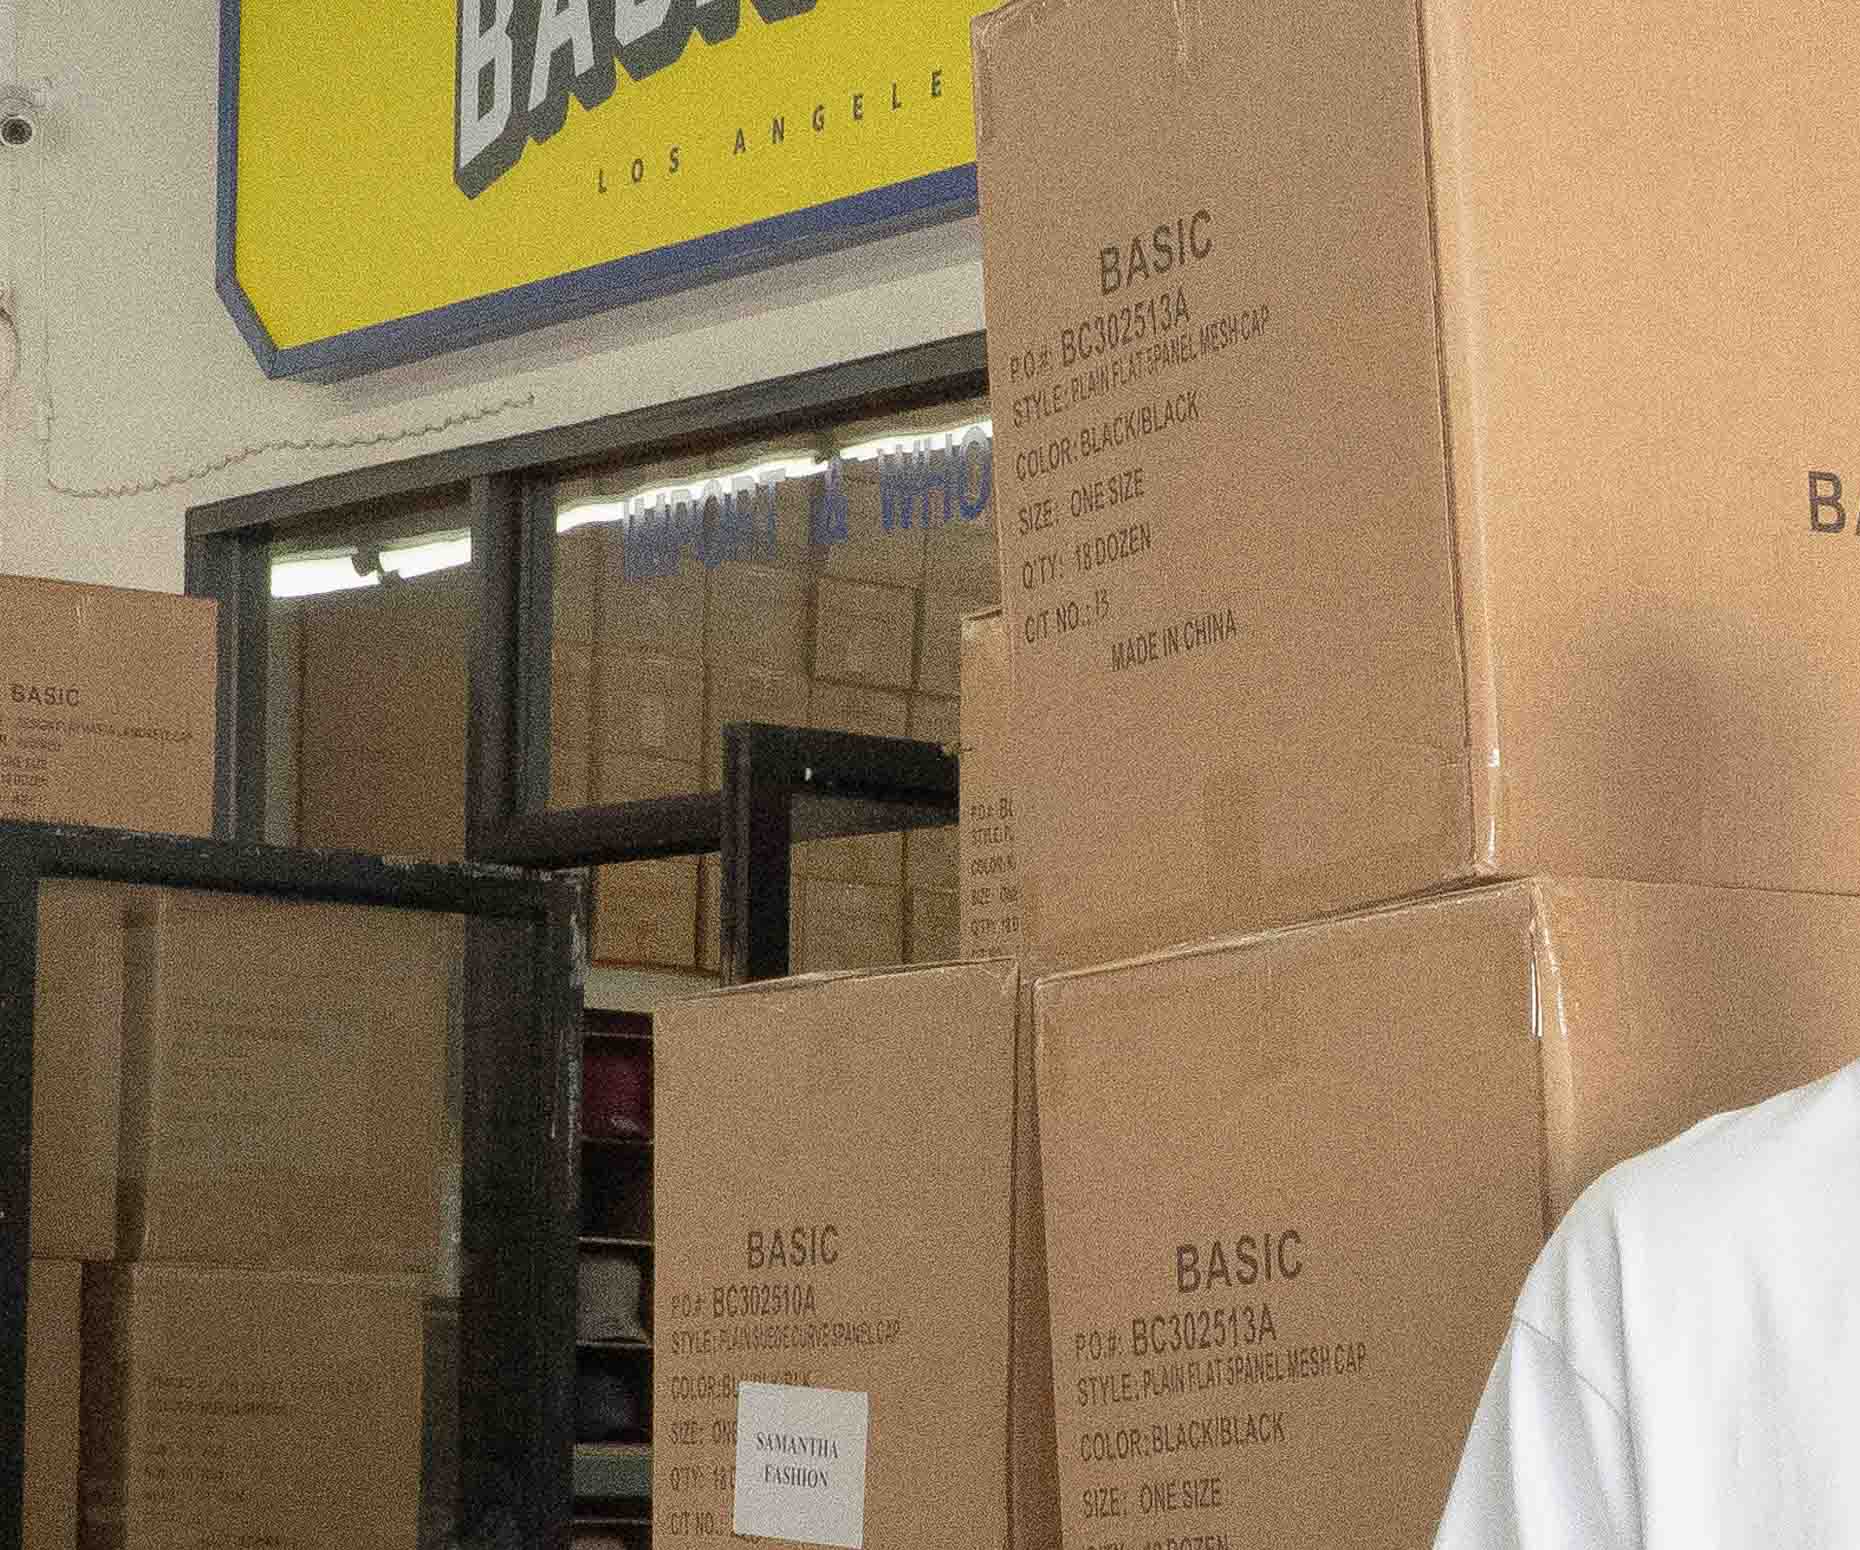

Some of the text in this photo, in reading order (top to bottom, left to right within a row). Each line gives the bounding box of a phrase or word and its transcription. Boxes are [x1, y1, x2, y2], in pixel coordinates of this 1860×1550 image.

[597, 69, 944, 194] LOS ANGELE
[1101, 209, 1213, 296] BASIC
[1061, 286, 1190, 367] BC302513A
[1013, 383, 1069, 428] STYLE:
[1071, 362, 1110, 402] PLAIN
[1199, 315, 1239, 355] MESH
[1240, 304, 1270, 341] CAP
[1016, 390, 1200, 482] COLOR: BLACK/BLACK
[878, 427, 992, 532] WHO
[1018, 468, 1145, 535] SIZE: ONE SIZE
[1096, 523, 1151, 567] DOZEN
[1111, 609, 1238, 672] MADE IN CHINA
[10, 681, 80, 708] BASIC
[748, 1224, 839, 1269] BASIC
[1175, 1230, 1303, 1293] BASIC
[712, 1283, 817, 1319] BC302510A
[1132, 1303, 1277, 1357] BC302513A
[1078, 1373, 1140, 1407] STYLE:
[1144, 1363, 1184, 1399] PLAIN
[1188, 1358, 1222, 1392] FLAT
[1287, 1345, 1330, 1384] MESH
[1334, 1341, 1366, 1375] CAP
[756, 1431, 839, 1459] SAMANTHA
[1080, 1411, 1287, 1462] COLOR: BLACK/BLACK
[764, 1463, 828, 1488] FASHION
[1083, 1477, 1222, 1518] SIZE: ONE SIZE
